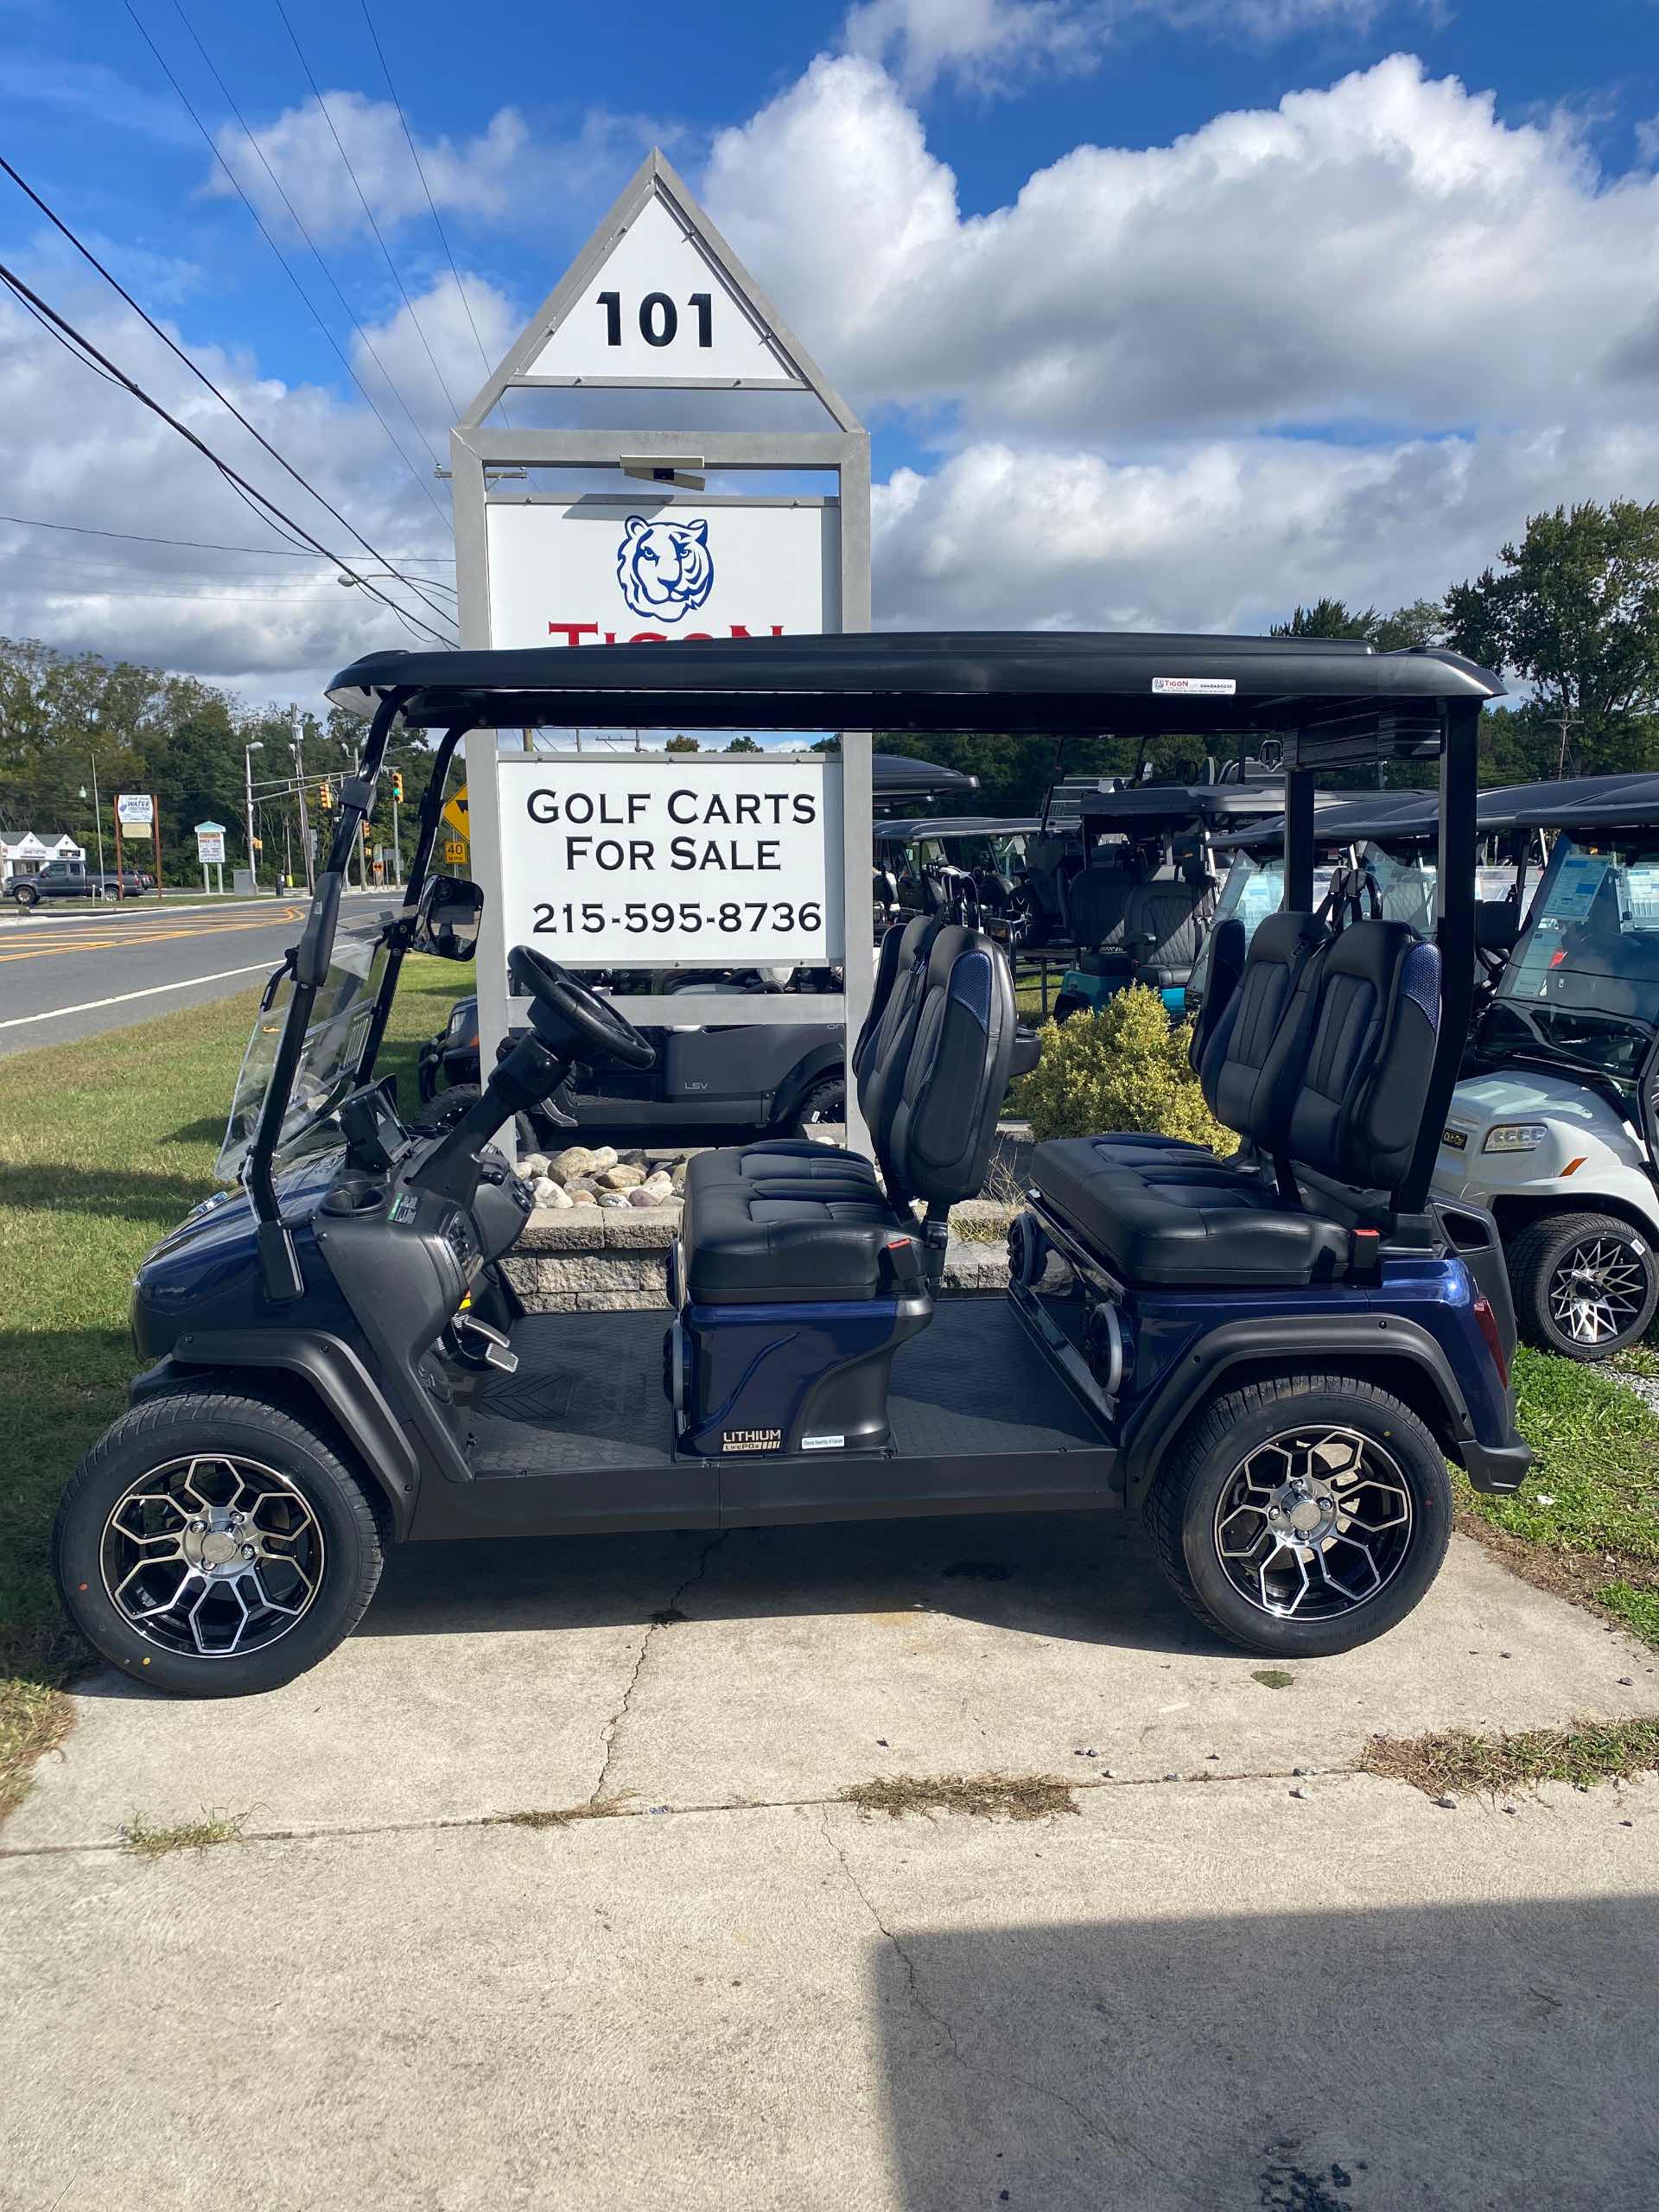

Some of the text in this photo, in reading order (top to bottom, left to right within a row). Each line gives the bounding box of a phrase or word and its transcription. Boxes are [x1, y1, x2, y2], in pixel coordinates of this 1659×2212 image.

[596, 291, 712, 347] 101
[527, 788, 816, 824] GOLF CARTS
[448, 843, 463, 855] 40
[566, 836, 781, 871] FOR SALE
[532, 902, 822, 933] 215-595-8736
[723, 1429, 781, 1442] LITHIUM
